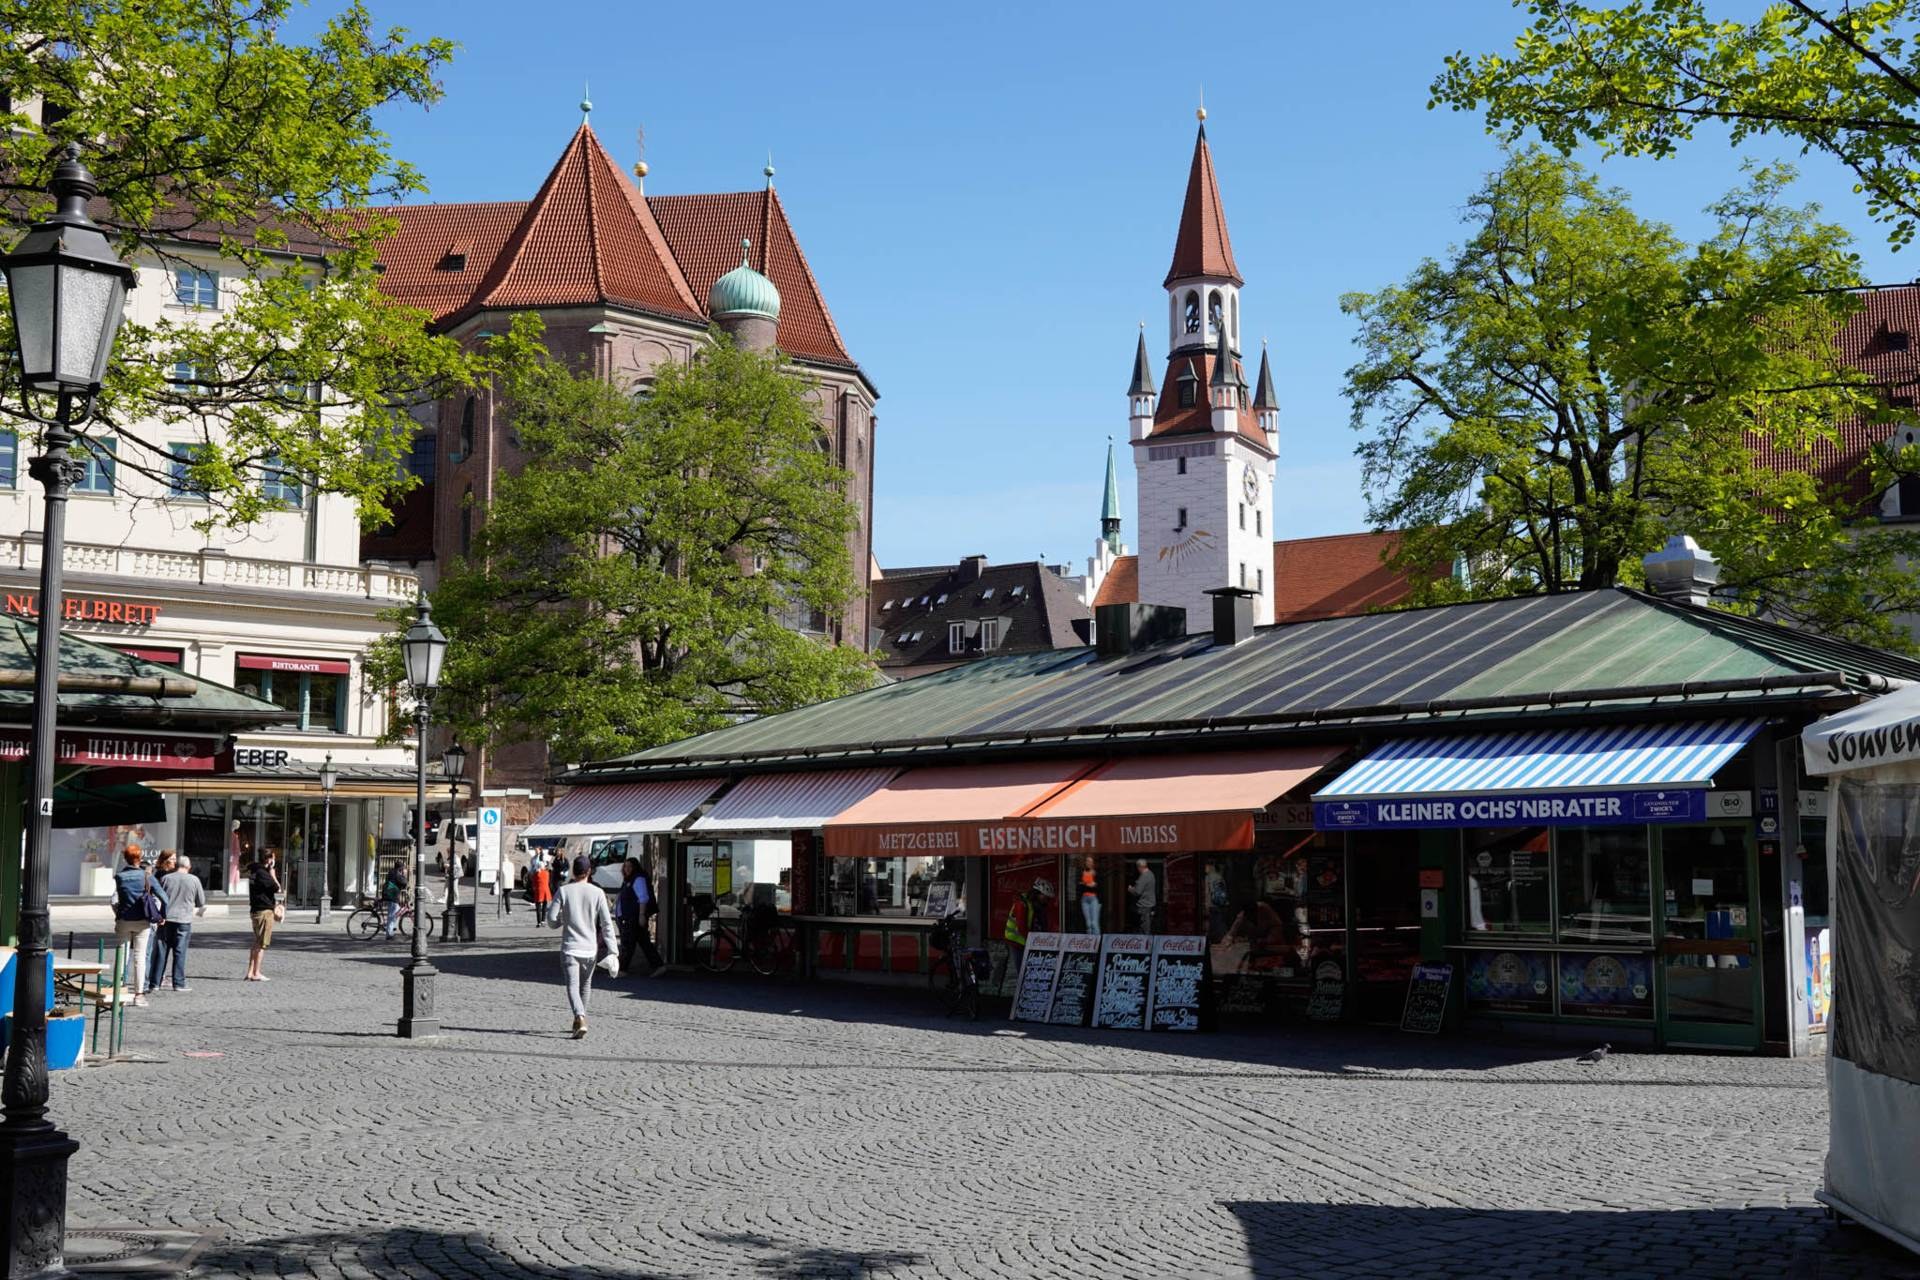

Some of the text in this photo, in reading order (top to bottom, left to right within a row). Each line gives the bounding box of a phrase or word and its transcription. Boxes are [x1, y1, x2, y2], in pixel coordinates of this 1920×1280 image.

[5, 593, 161, 624] NUELBRETT
[272, 661, 320, 671] RISTORANTE
[60, 738, 76, 758] in
[87, 738, 166, 763] HEIMAT
[1828, 722, 1920, 764] Souven
[233, 749, 289, 766] EBER
[41, 801, 49, 813] 4
[1377, 801, 1457, 822] KLEINER
[1459, 797, 1622, 821] OCHS'NBRATER
[1723, 798, 1739, 807] BIO
[879, 824, 1178, 850] METZGEREI EISENREICH IMBISS
